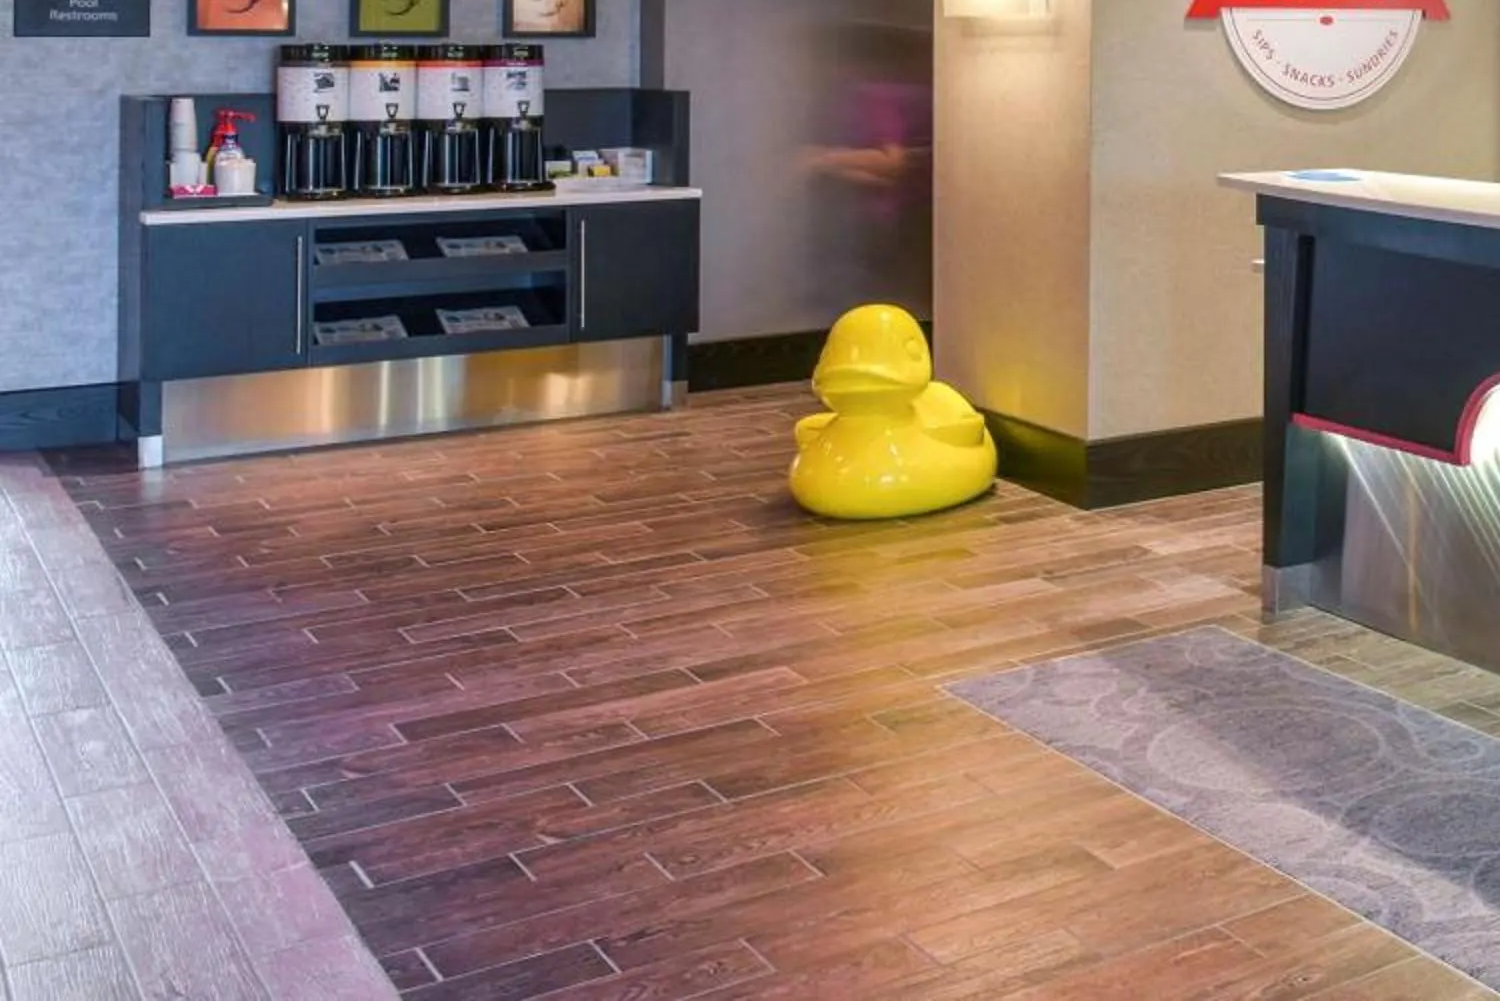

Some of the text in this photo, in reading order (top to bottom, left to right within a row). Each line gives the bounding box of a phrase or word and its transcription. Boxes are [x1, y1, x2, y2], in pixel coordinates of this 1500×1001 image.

[50, 9, 118, 21] Restrooms
[1252, 30, 1399, 88] SIPS SNACKS SUNDRIES
